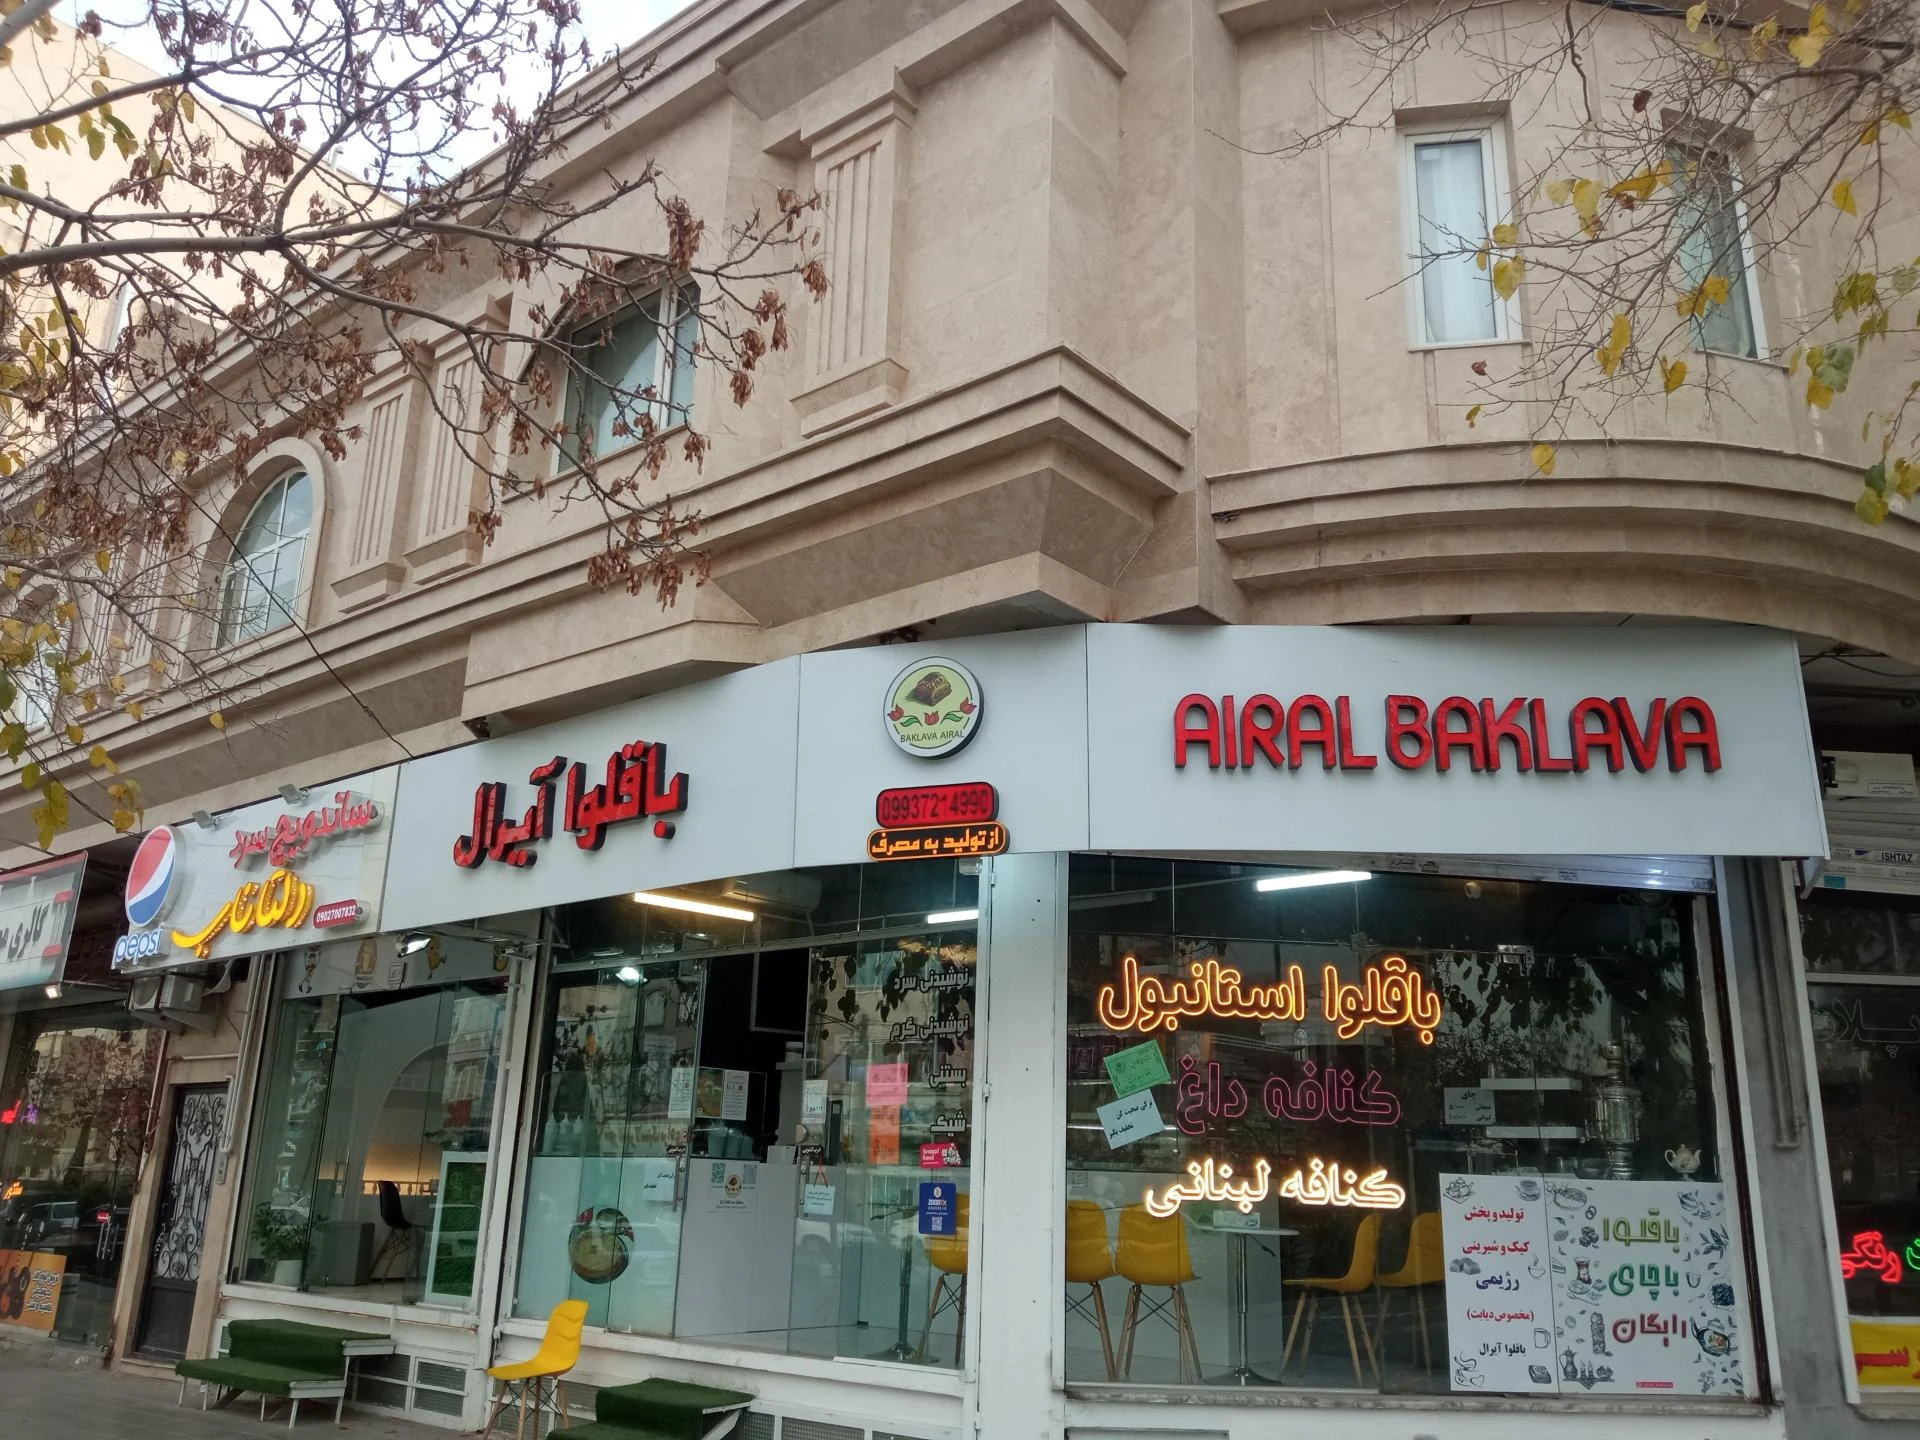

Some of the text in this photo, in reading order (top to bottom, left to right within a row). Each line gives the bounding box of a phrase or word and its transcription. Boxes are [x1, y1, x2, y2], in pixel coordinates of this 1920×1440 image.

[900, 730, 965, 743] BAKLAVA AIRAL
[1174, 693, 1722, 774] AIRAL BAKLAVA
[453, 740, 689, 869] باقلوا آیرال
[269, 790, 376, 867] ساندویچ
[872, 827, 999, 856] از تولید به مصرف
[111, 925, 164, 969] pepsi
[894, 966, 970, 994] نوشیدنی سرد
[1099, 957, 1442, 1045] باقلوا استانبول
[890, 1012, 970, 1042] نوشیدنی گرم
[929, 1064, 967, 1089] بستنی
[1264, 1060, 1401, 1125] کنافه
[1176, 1054, 1248, 1135] داغ
[1461, 1090, 1476, 1100] چای
[930, 1109, 967, 1137] شیک
[1146, 1157, 1406, 1218] کنافه لبنانی
[1464, 1206, 1524, 1223] تولید و پخش
[1603, 1207, 1680, 1254] باقلوا
[1462, 1240, 1530, 1255] کیک و شیرینی
[1476, 1270, 1520, 1291] رژیمی
[1608, 1263, 1679, 1301] با چای
[1612, 1313, 1687, 1348] رایگان
[1479, 1342, 1526, 1357] باقلوا آیرال
